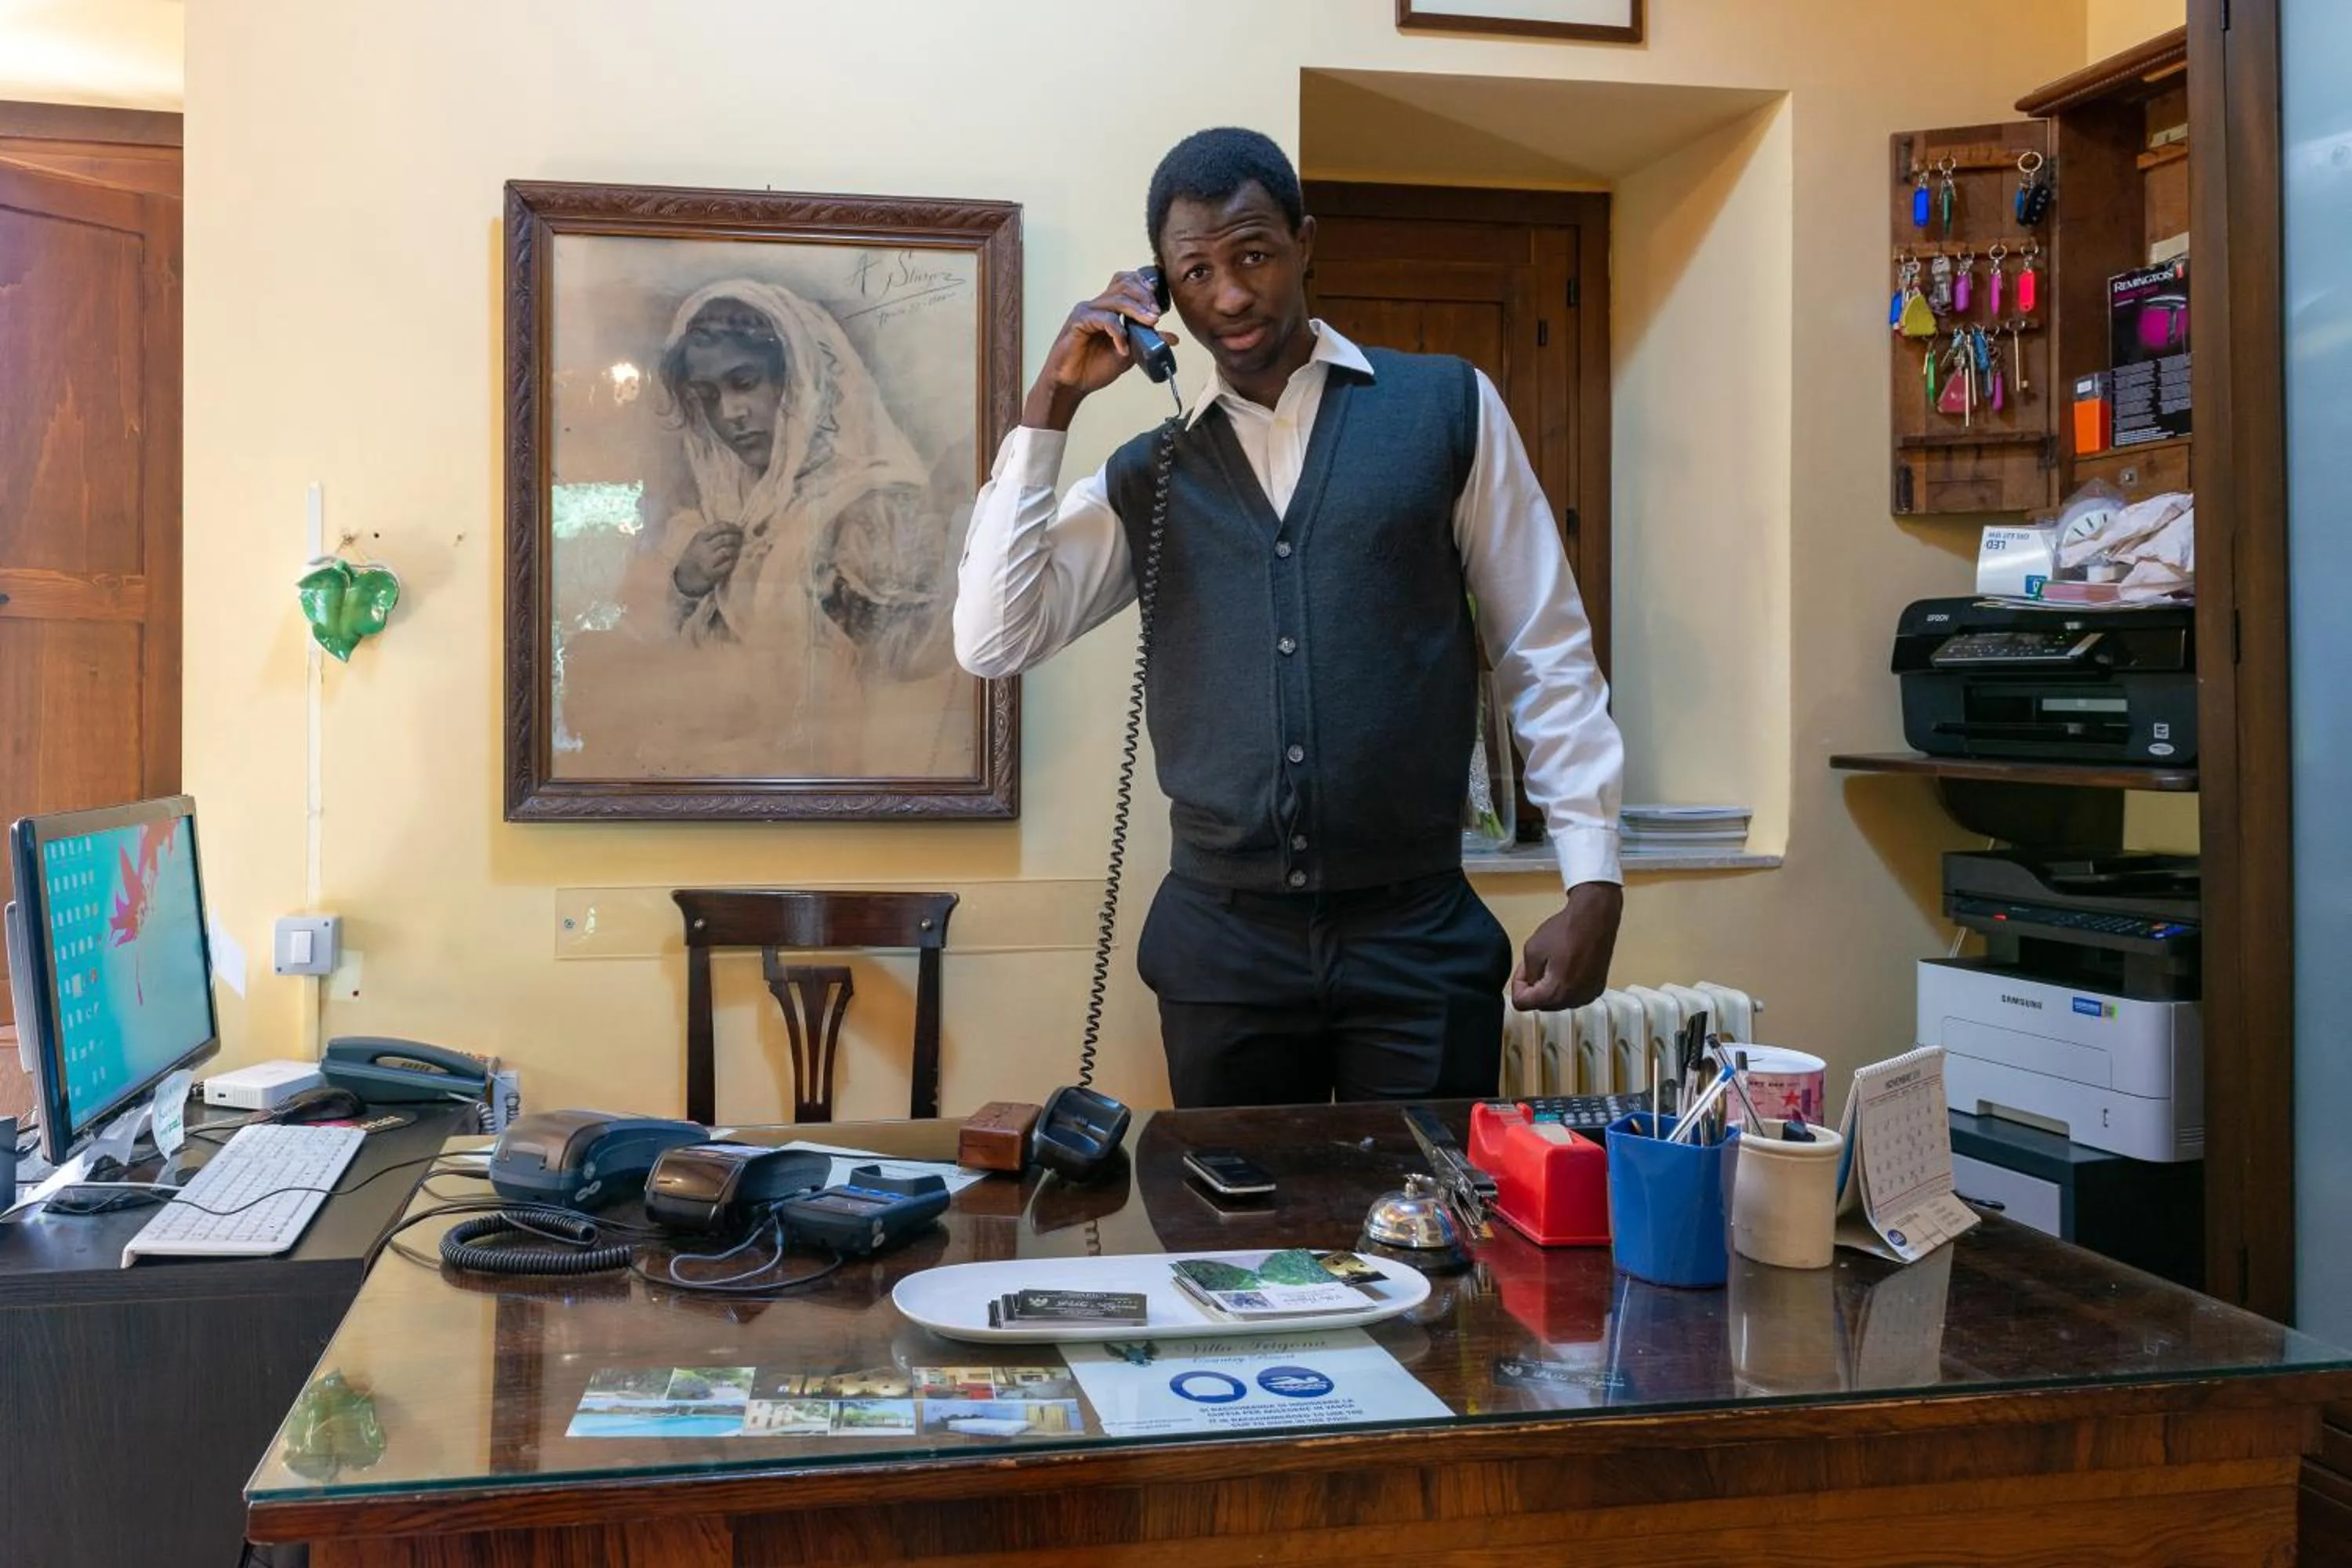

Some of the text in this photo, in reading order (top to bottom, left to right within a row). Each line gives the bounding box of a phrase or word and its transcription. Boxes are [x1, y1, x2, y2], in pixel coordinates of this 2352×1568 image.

[2114, 269, 2174, 293] REMINGTON
[1986, 539, 2006, 550] LED
[2001, 994, 2042, 1010] SAMSUNG
